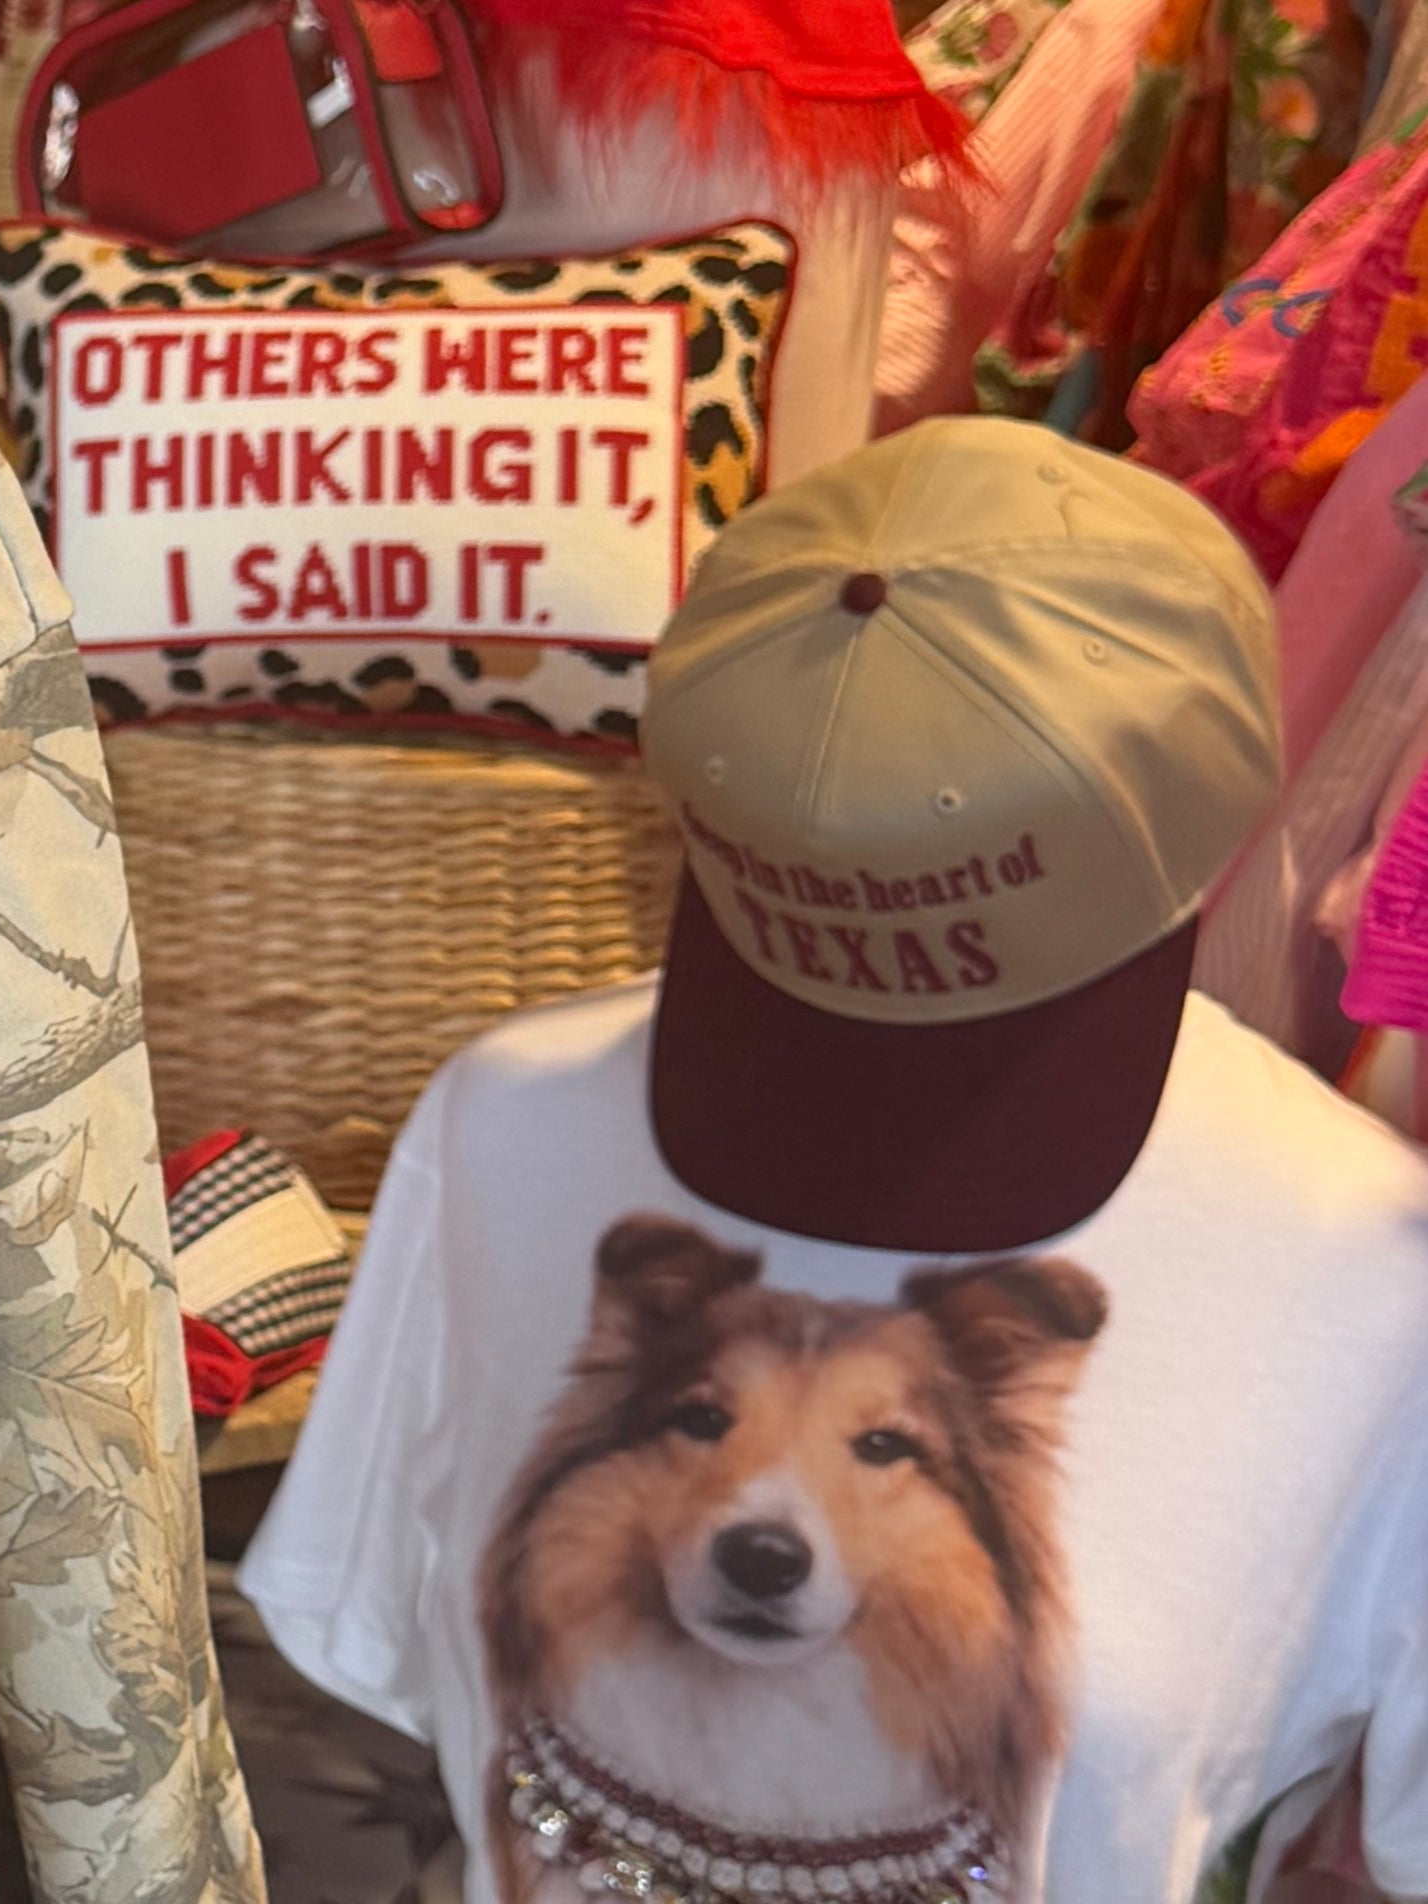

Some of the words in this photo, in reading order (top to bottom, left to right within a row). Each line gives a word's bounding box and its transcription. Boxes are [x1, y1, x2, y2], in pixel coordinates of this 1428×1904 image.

[72, 327, 398, 407] OTHERS
[421, 326, 650, 396] WERE
[71, 429, 535, 518] THINKING
[555, 426, 657, 525] IT,
[166, 549, 193, 627] I
[233, 543, 430, 623] SAID
[458, 543, 552, 624] IT.
[787, 862, 858, 910] the
[857, 854, 994, 913] heart
[996, 831, 1046, 888] of
[734, 884, 1001, 995] TEXAS
